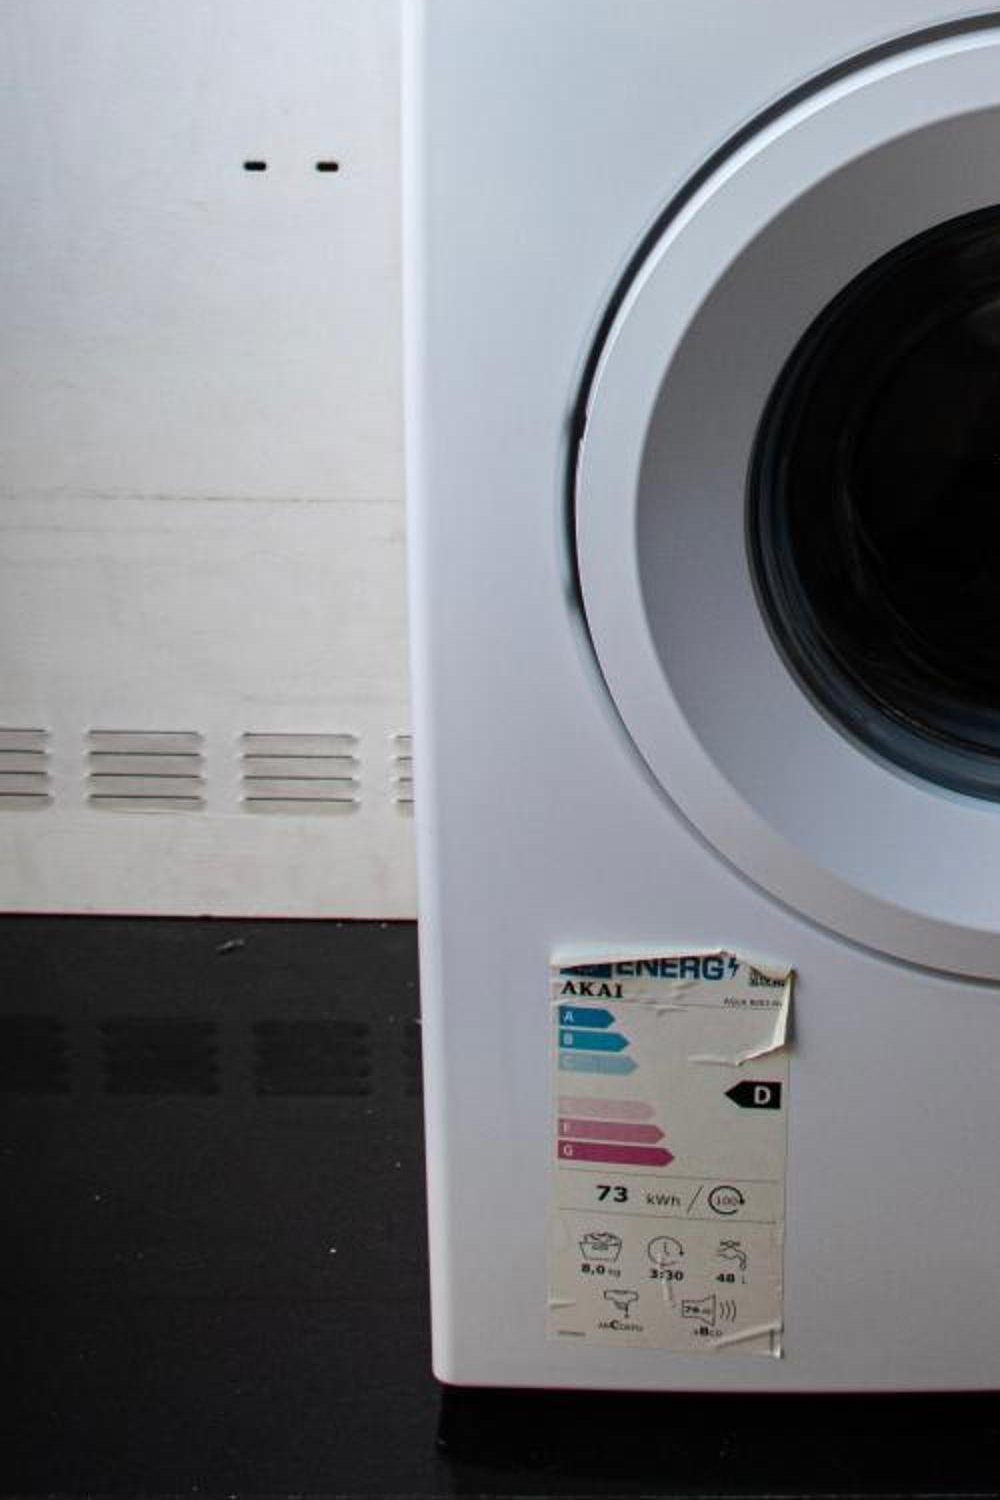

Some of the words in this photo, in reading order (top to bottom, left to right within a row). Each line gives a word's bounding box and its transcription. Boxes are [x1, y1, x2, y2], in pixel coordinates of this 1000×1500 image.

[561, 980, 623, 998] AKAI
[563, 1008, 574, 1022] A
[563, 1031, 573, 1045] B
[754, 1088, 771, 1105] D
[596, 1184, 628, 1203] 73
[646, 1192, 681, 1207] kWh
[581, 1263, 605, 1277] 8,0
[649, 1268, 684, 1281] 3:30
[716, 1273, 736, 1283] 48
